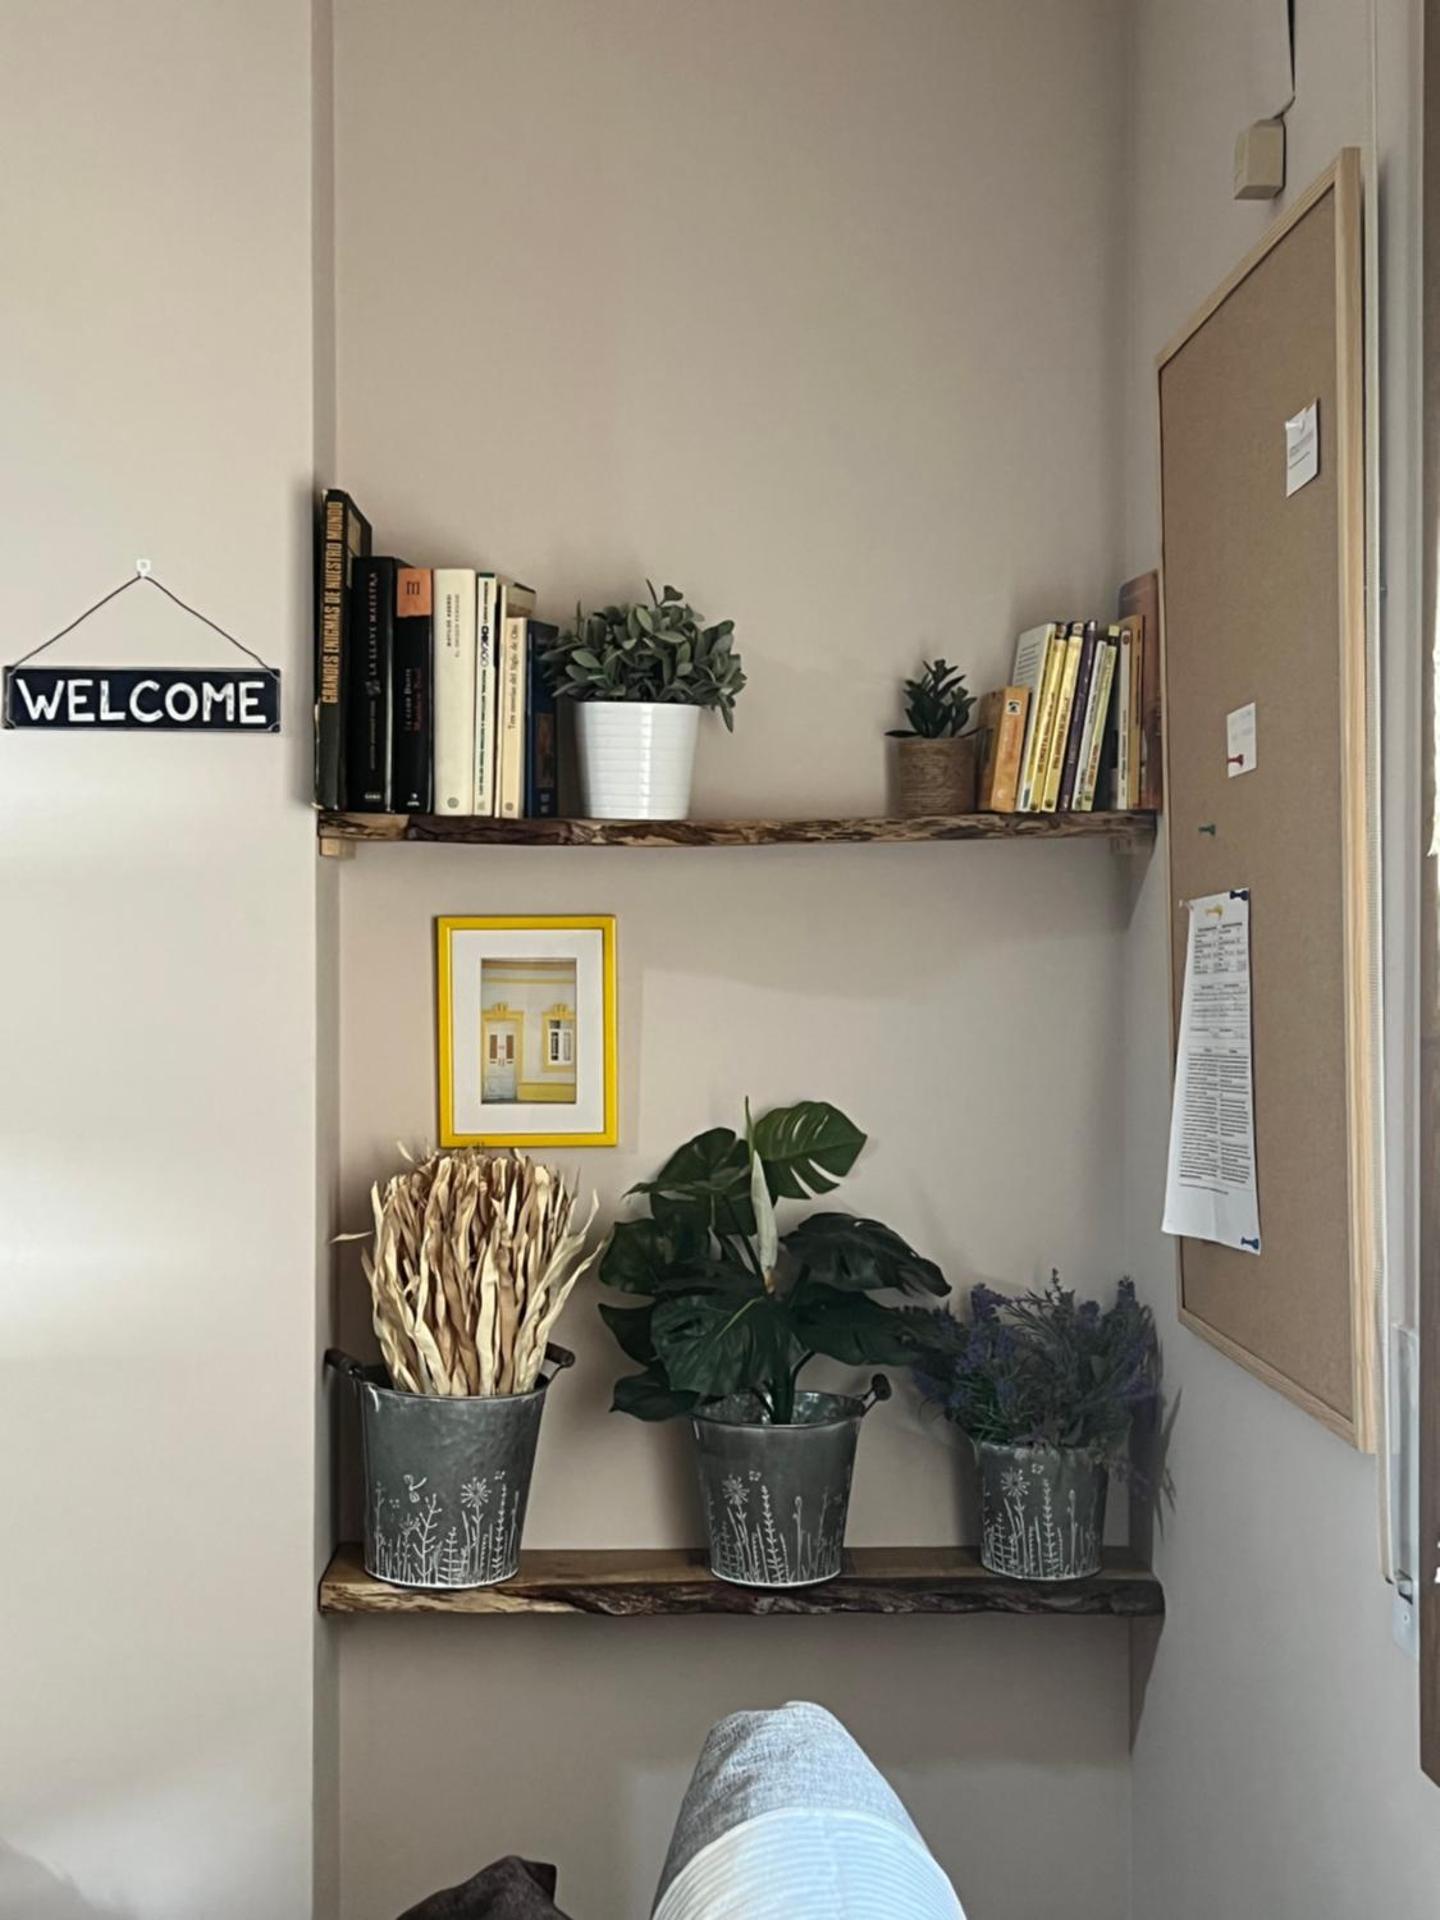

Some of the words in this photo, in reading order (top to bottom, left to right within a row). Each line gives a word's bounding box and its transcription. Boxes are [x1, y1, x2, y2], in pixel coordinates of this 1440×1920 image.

[326, 502, 343, 540] MUNDO
[325, 543, 342, 588] NUESTRO
[324, 588, 341, 604] DE
[368, 573, 378, 622] MAESTRA
[323, 606, 340, 653] ENIGMAS
[368, 626, 377, 659] LLAVE
[322, 655, 339, 703] GRANDES
[368, 663, 377, 675] LA
[16, 678, 267, 724] WELCOME
